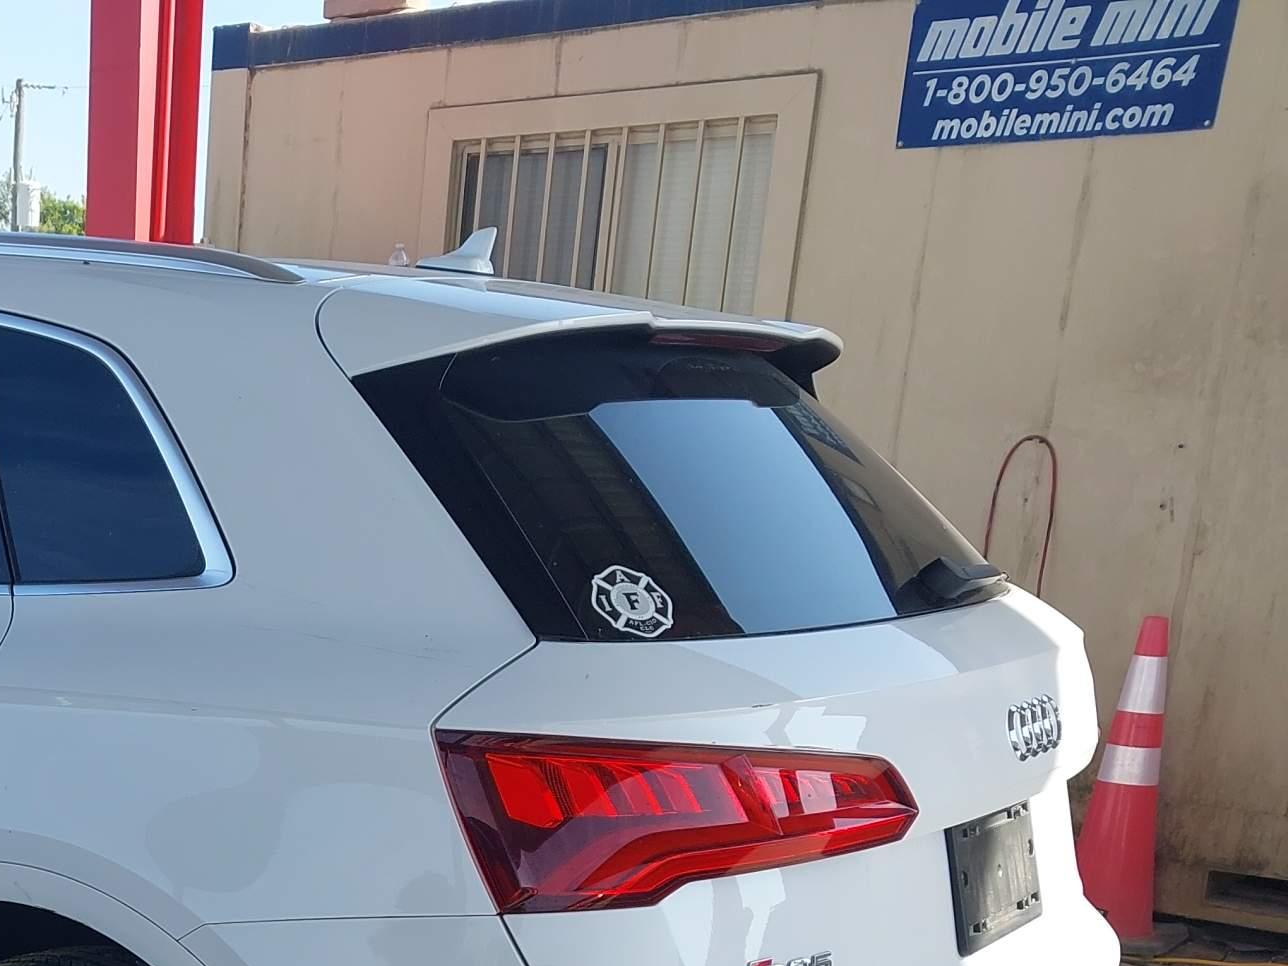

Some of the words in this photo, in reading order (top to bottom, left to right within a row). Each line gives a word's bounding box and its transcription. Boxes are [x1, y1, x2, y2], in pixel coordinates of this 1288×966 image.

[916, 0, 1091, 62] mobile
[1090, 0, 1220, 47] mini
[922, 54, 1201, 108] 1-800-950-6464
[931, 101, 1175, 141] mobilemini.com
